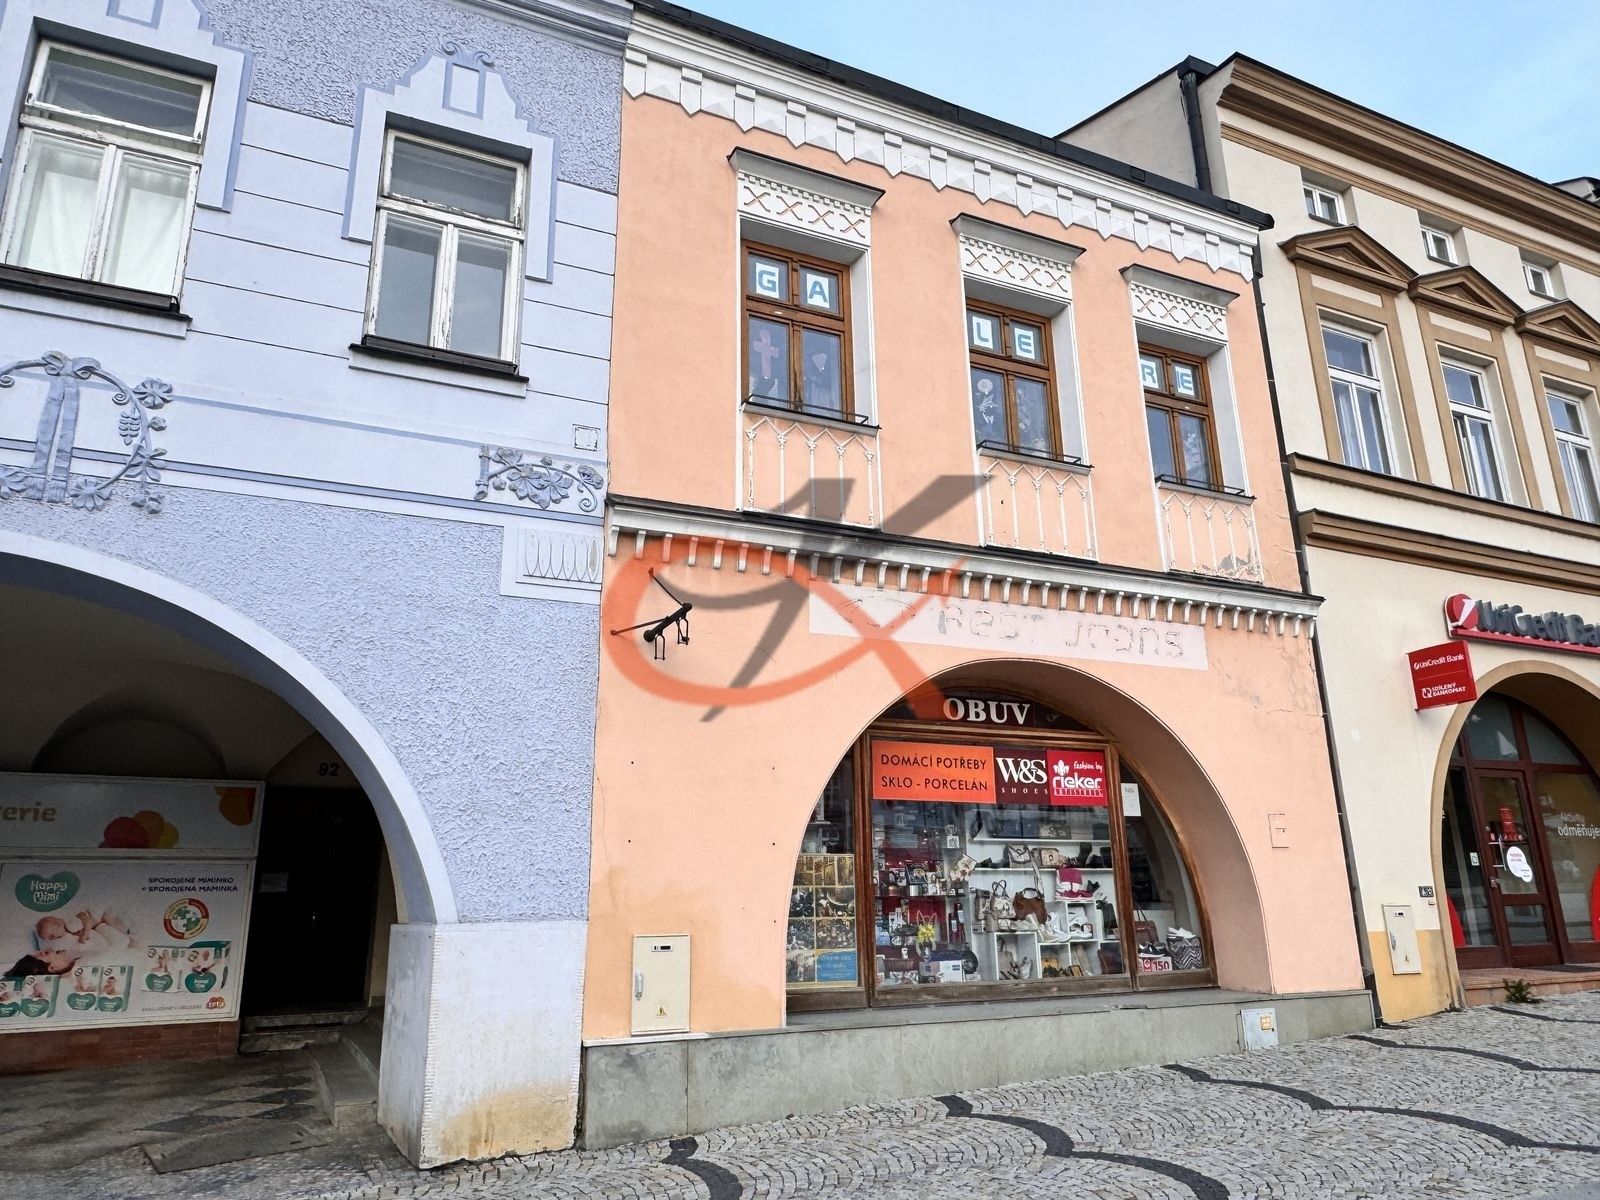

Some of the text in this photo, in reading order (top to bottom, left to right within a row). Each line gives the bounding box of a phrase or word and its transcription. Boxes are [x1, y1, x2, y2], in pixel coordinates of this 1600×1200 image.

[1420, 653, 1465, 669] UniCredit Bank
[1433, 686, 1466, 697] BANKOMAT
[943, 697, 1030, 725] OBUV
[318, 762, 340, 777] 92
[881, 753, 986, 771] DOMÁCÍ POTŘEBY
[1095, 761, 1103, 774] by
[995, 757, 1048, 785] W&S
[881, 777, 912, 788] SKLO
[924, 778, 988, 791] PORCELÁN
[1052, 772, 1103, 789] rieker
[0, 801, 57, 822] erie
[30, 880, 68, 891] Happy
[1153, 961, 1170, 971] 150
